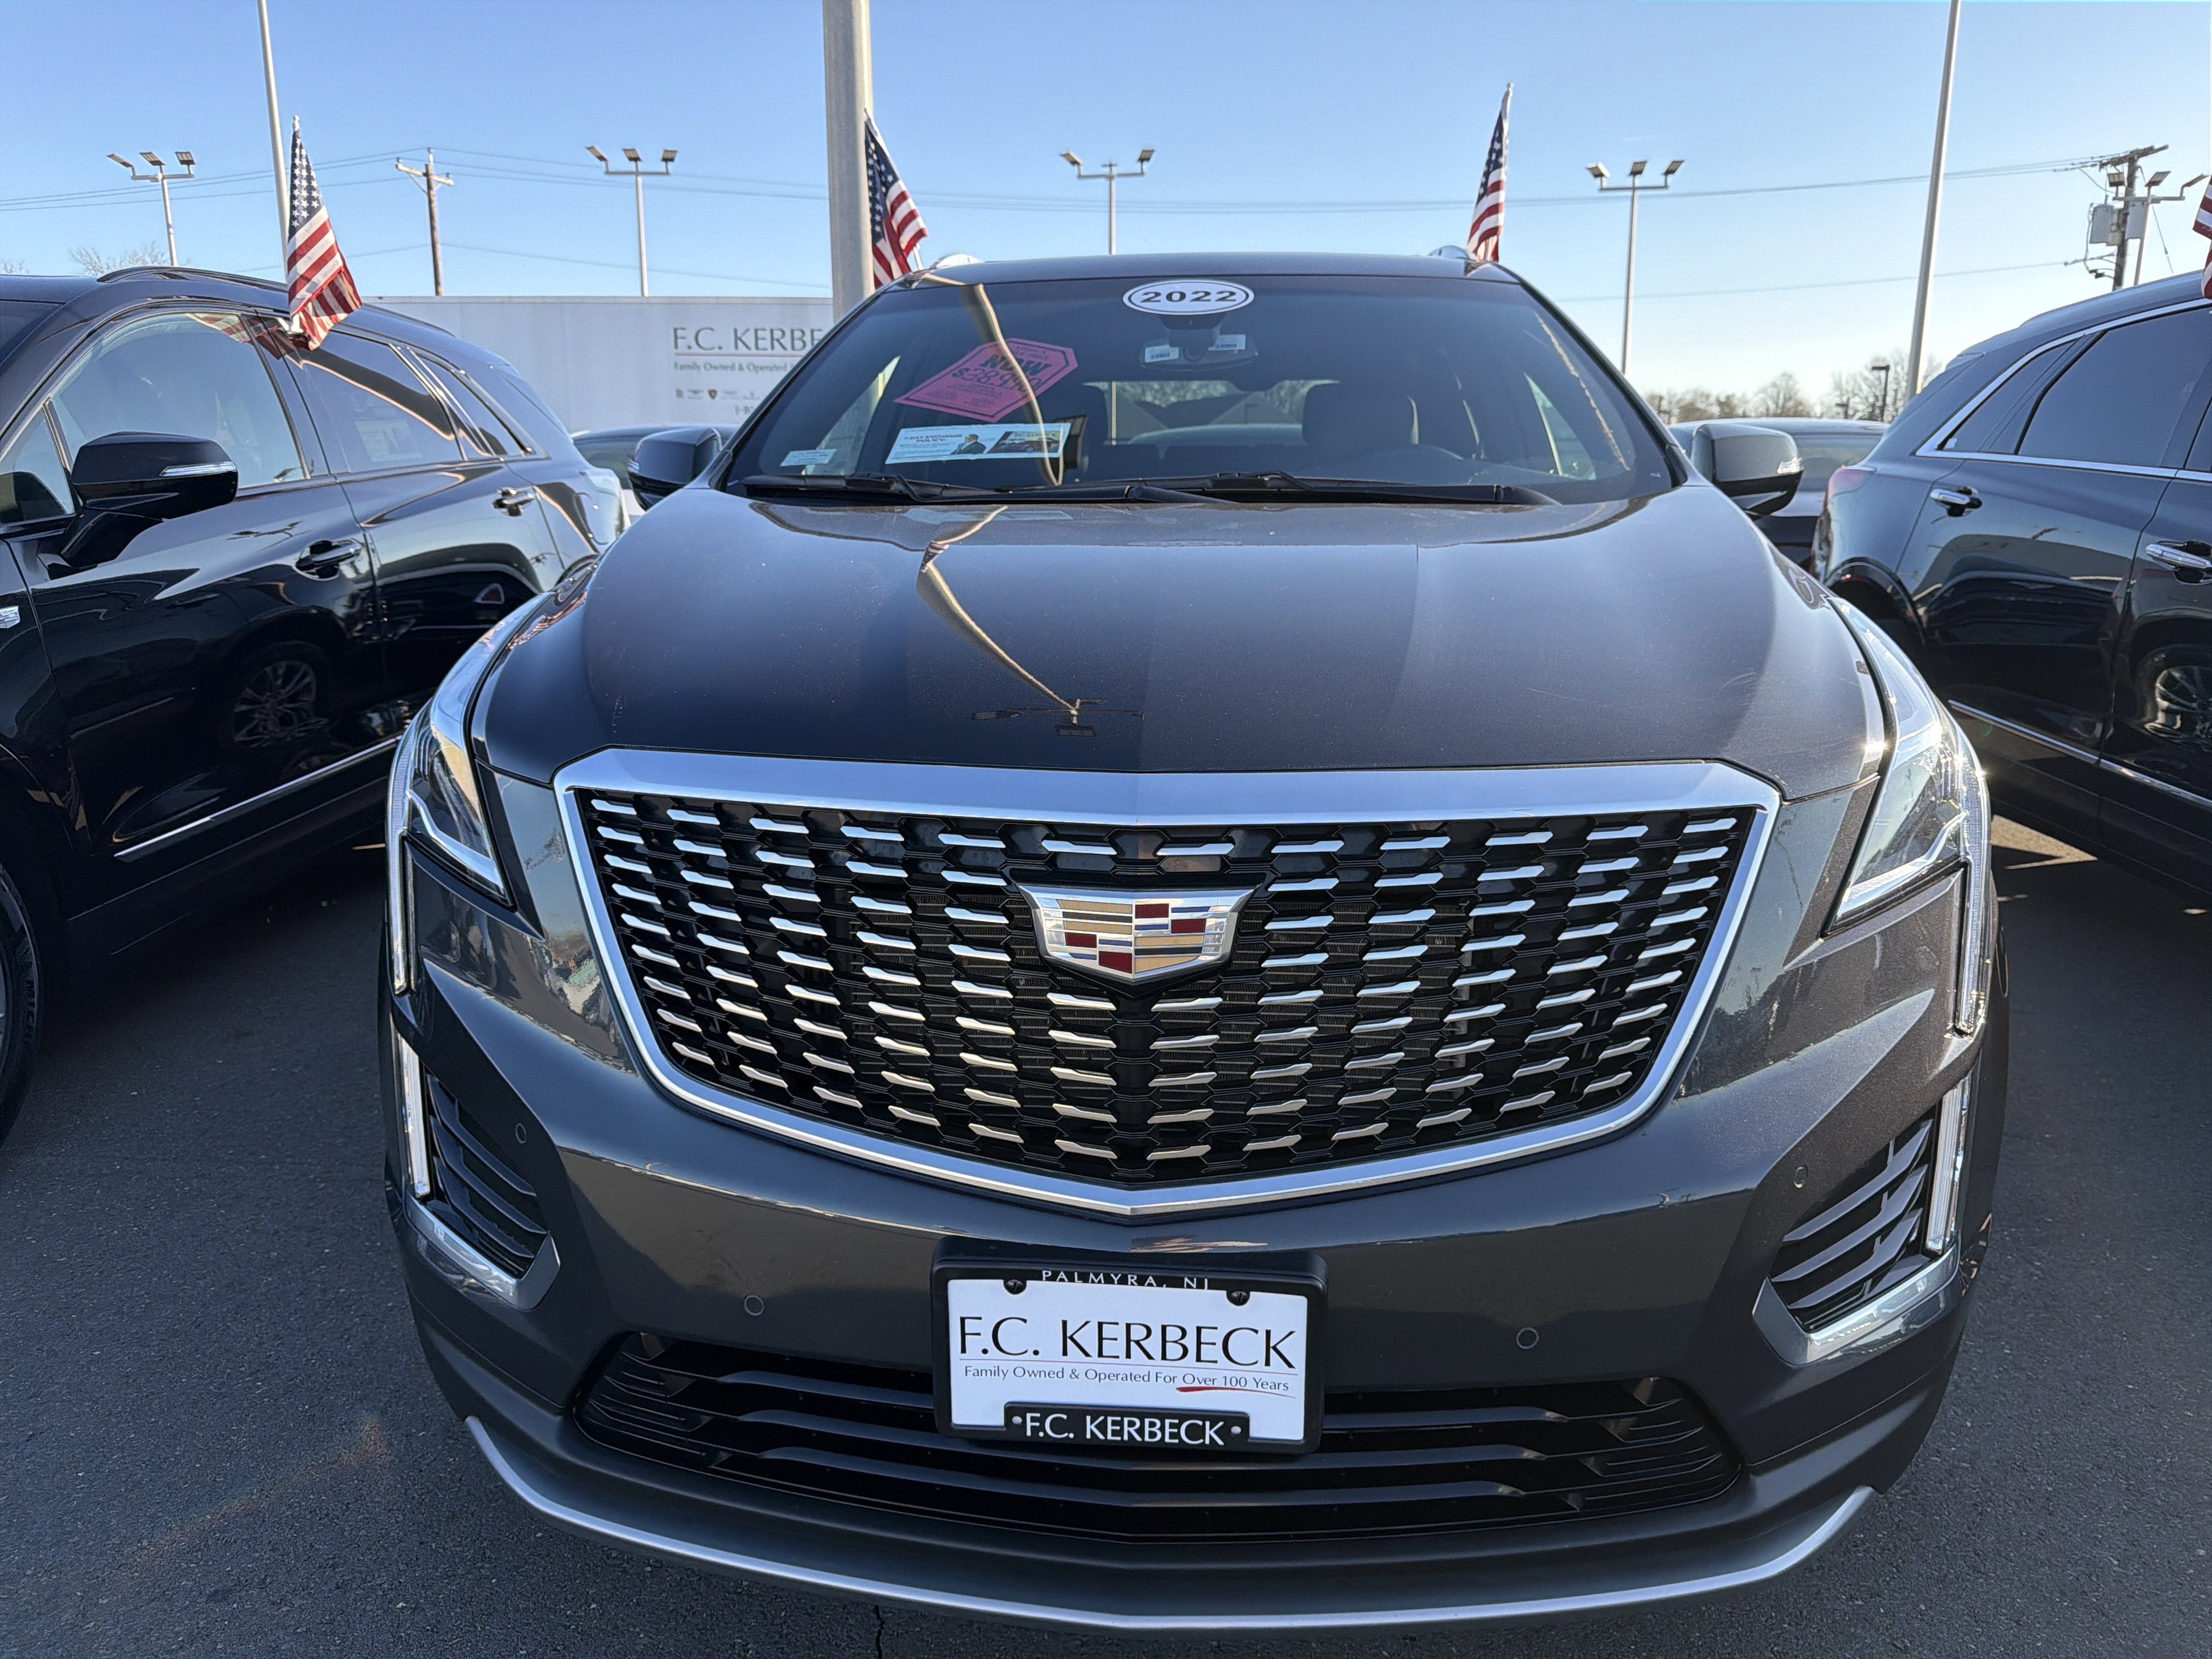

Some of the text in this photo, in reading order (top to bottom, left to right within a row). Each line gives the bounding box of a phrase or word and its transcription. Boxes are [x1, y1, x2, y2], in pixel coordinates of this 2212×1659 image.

[1140, 290, 1237, 303] 2022
[673, 326, 823, 351] F.C. KERBE
[674, 362, 701, 373] Family
[703, 362, 736, 371] Owned
[979, 355, 1053, 376] NOW
[1042, 1270, 1208, 1290] PALMYRA, NJ
[960, 1316, 1296, 1369] F.C. KERBECK
[964, 1365, 1289, 1391] Family Owned & Operated For Over 100 Years
[1026, 1413, 1225, 1446] F.C. KERBECK
